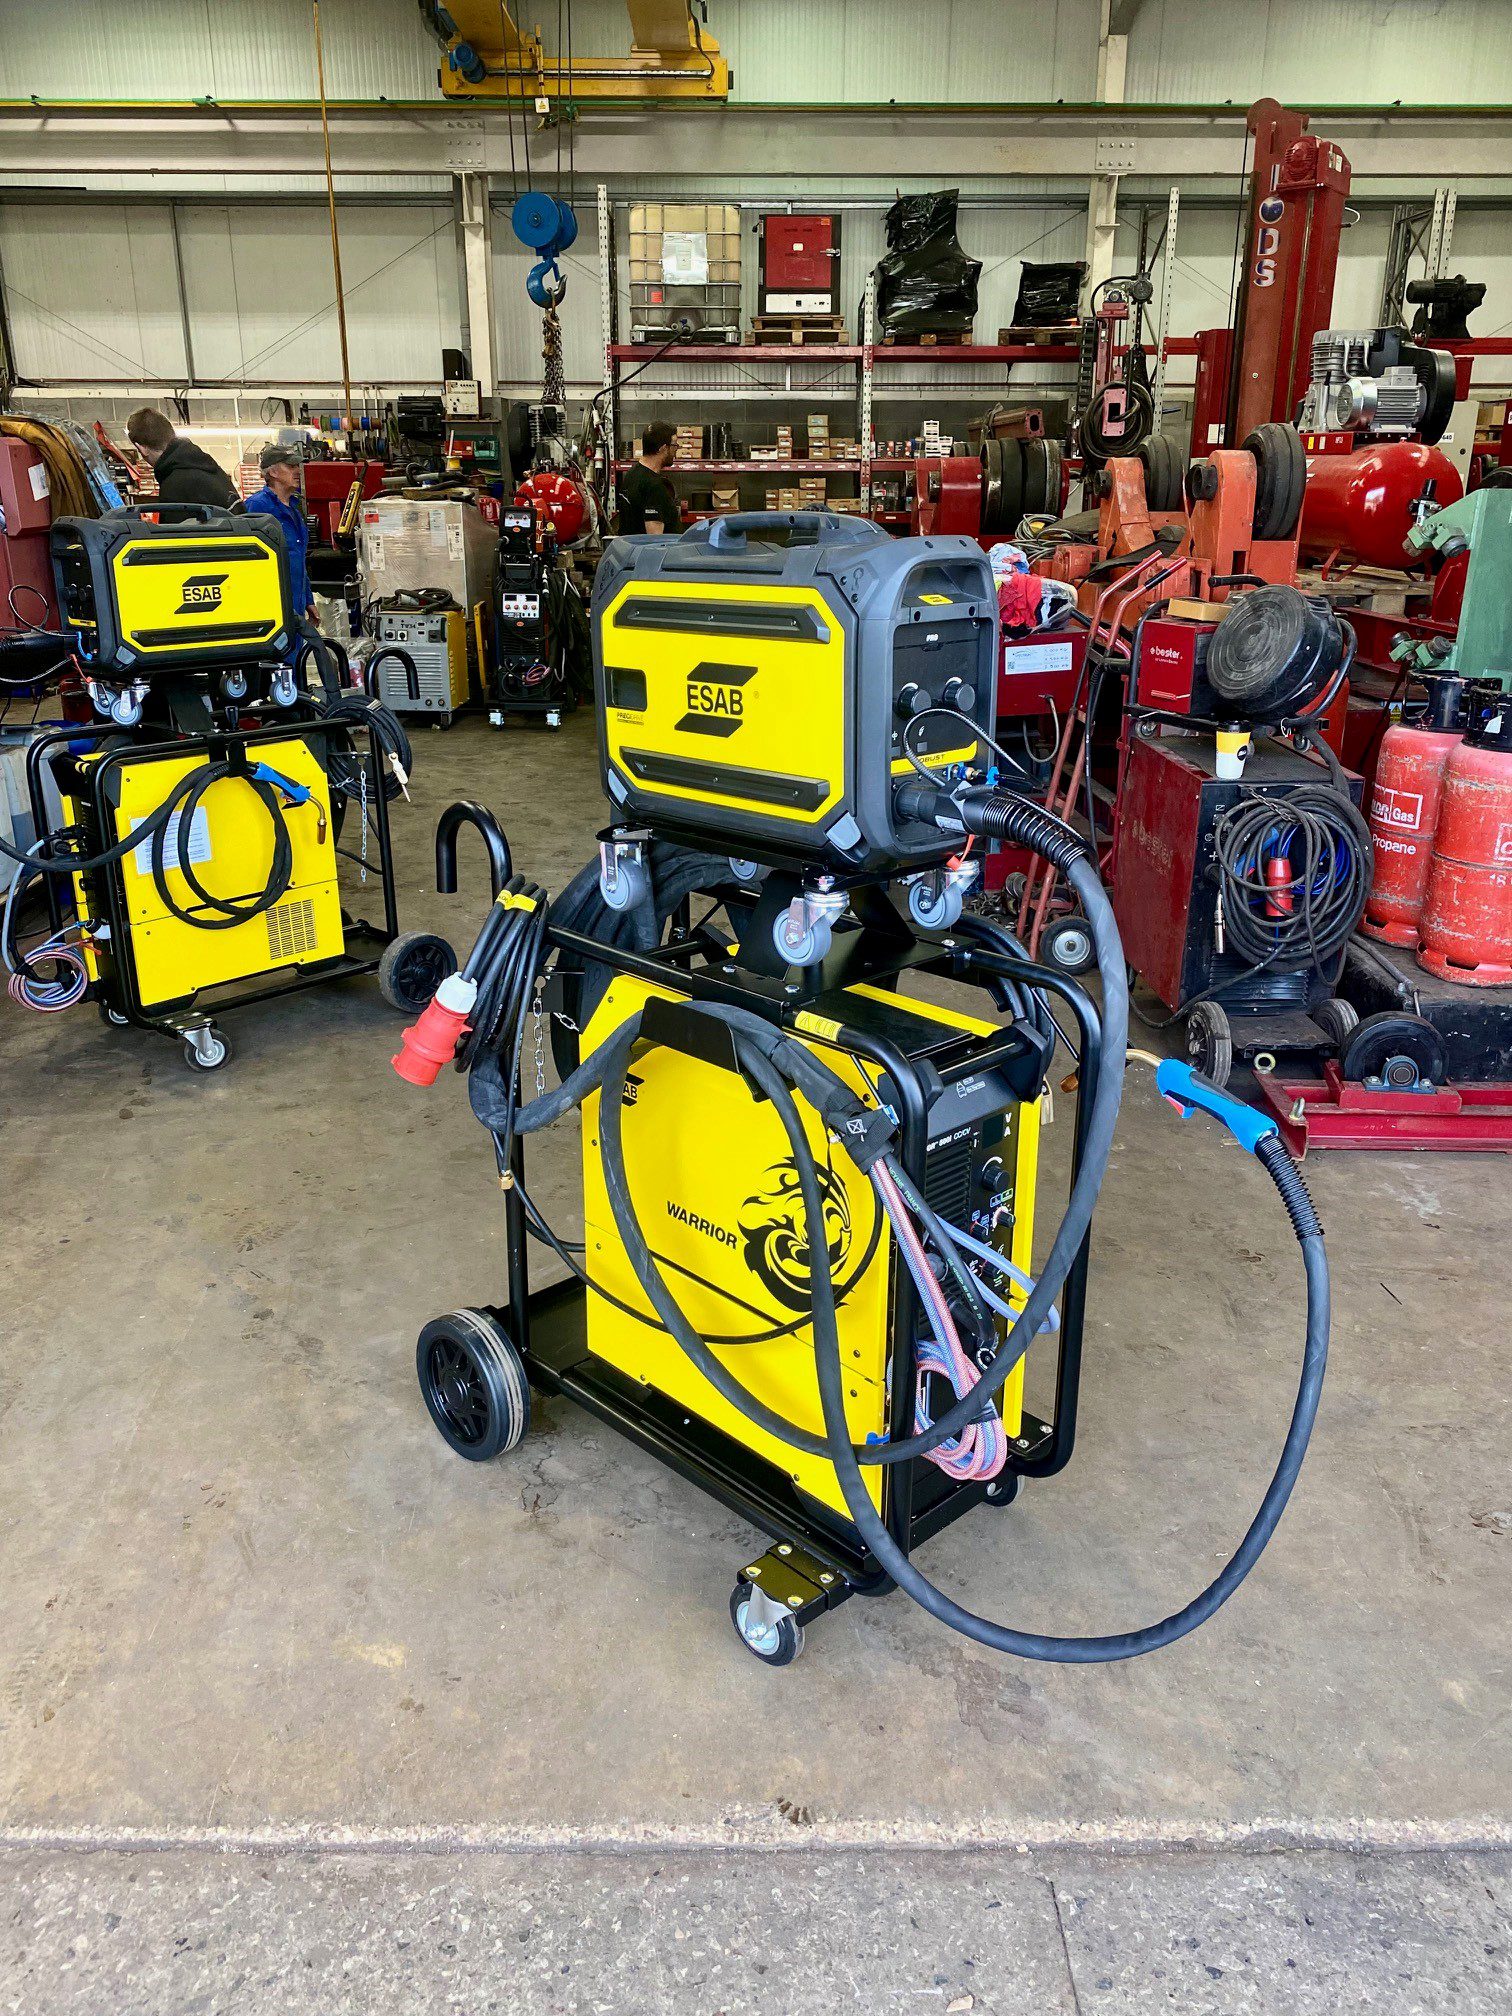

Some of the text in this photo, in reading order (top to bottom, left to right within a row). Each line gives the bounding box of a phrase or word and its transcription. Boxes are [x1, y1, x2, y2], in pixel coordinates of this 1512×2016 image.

[182, 587, 222, 602] ESAB
[1155, 645, 1181, 660] bester
[687, 684, 744, 716] ESAB
[919, 753, 945, 763] OBUST
[1393, 808, 1415, 823] Gas
[1372, 833, 1416, 855] Propane
[622, 1085, 638, 1099] AB
[1005, 1112, 1012, 1123] V
[1003, 1125, 1011, 1137] A
[903, 1189, 921, 1214] FRANCE
[666, 1200, 739, 1250] WARRIOR
